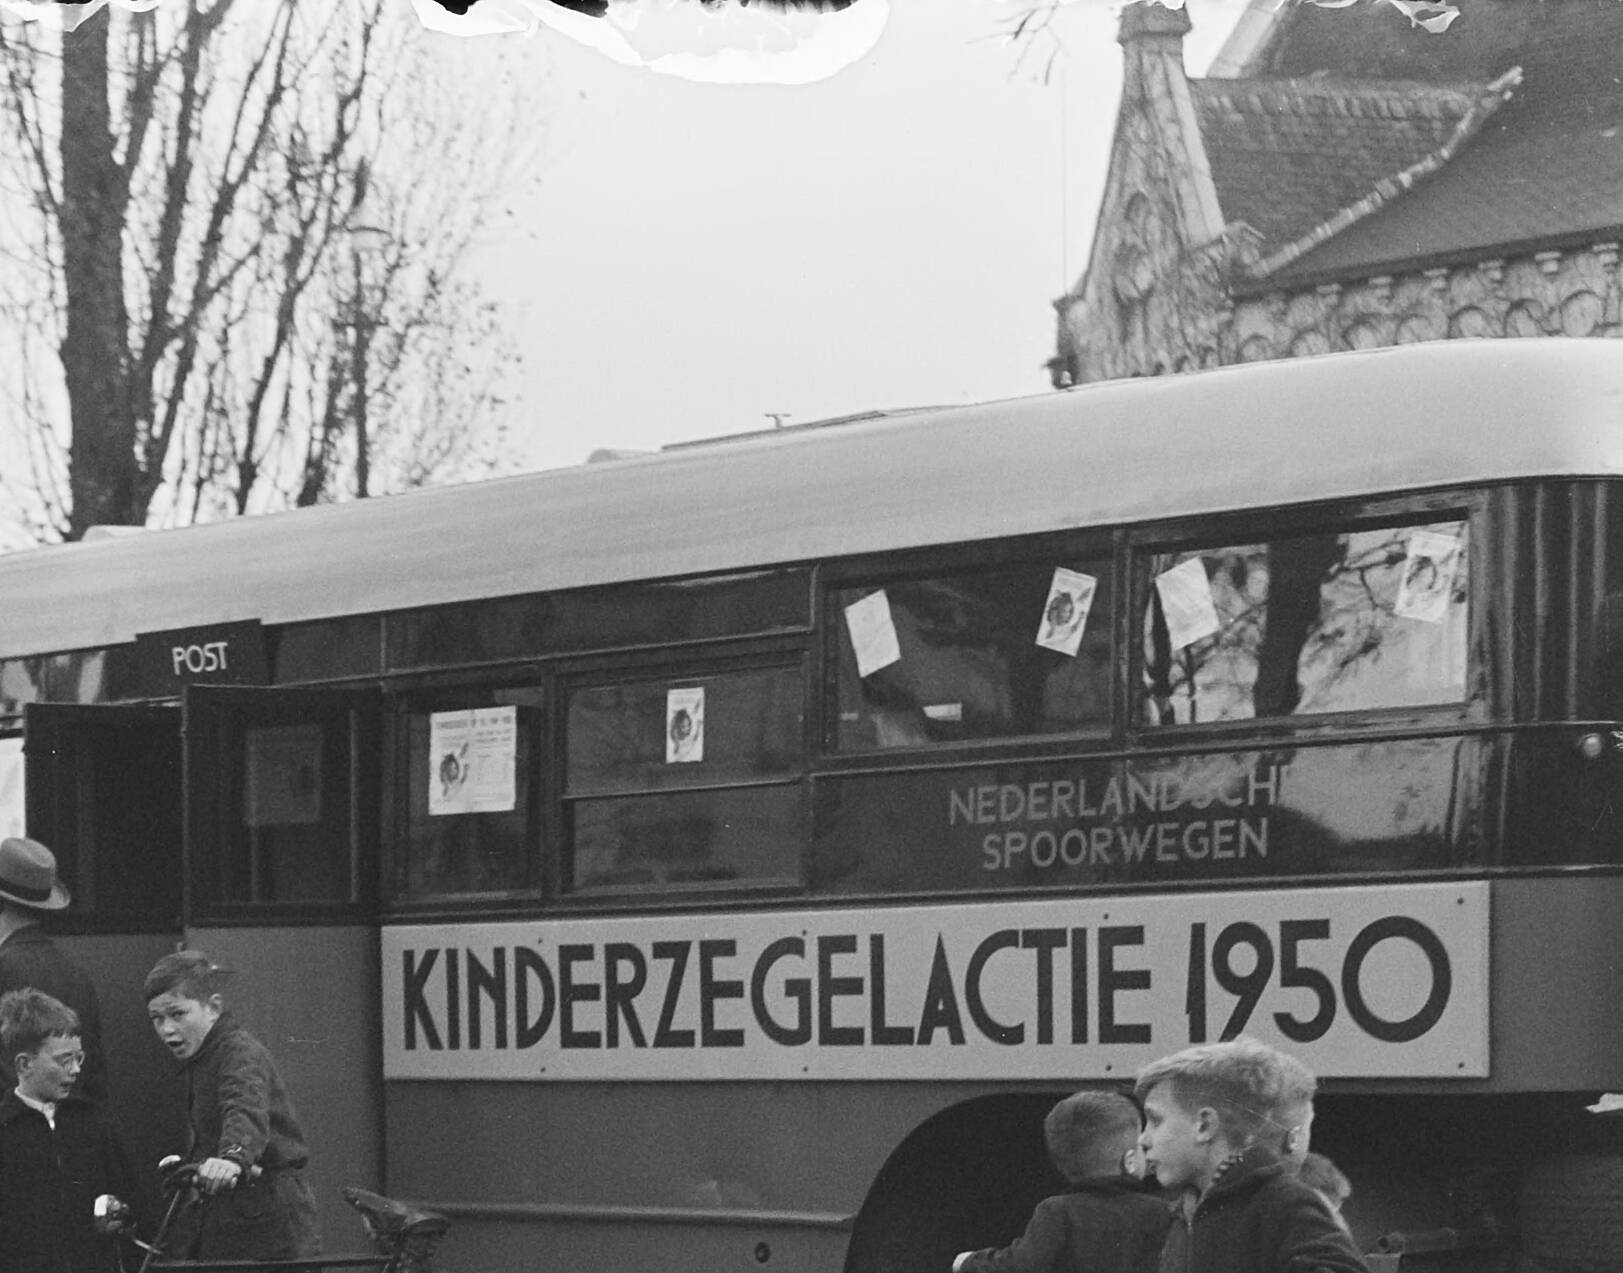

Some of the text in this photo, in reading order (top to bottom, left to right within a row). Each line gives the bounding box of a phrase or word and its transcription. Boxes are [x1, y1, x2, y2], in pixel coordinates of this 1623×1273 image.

[172, 641, 228, 675] POST
[982, 817, 1269, 870] SPOORWEGEN
[402, 915, 1452, 1050] KINDERZEGELACTIE 1950
